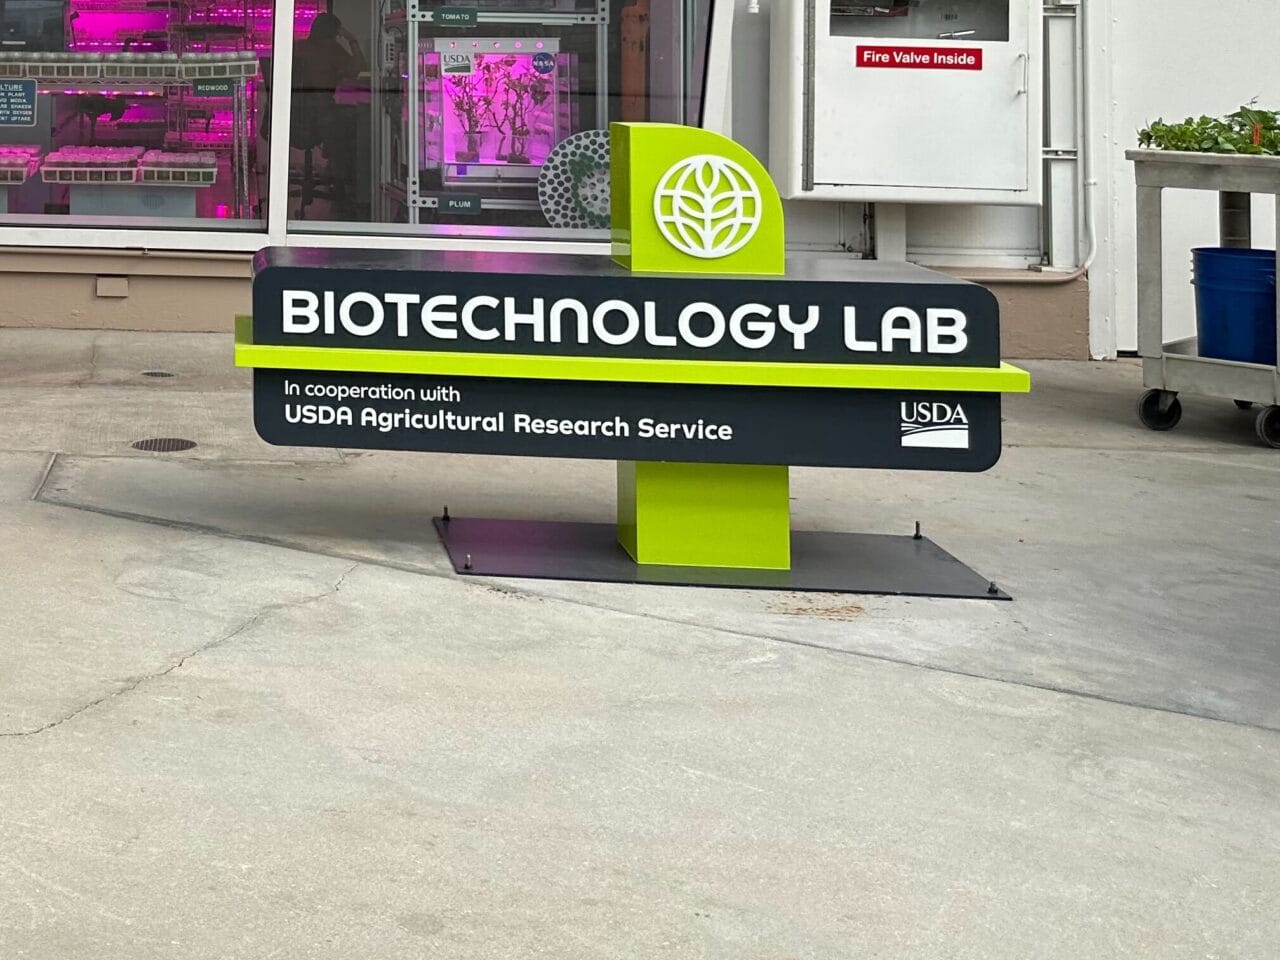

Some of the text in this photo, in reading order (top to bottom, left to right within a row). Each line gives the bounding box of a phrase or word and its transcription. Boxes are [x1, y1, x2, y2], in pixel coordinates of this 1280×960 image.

[443, 54, 471, 64] USDA
[863, 50, 976, 66] Fire Valve Inside
[449, 200, 471, 208] PLUM
[282, 290, 968, 354] BIOTECHNOLOGY LAB
[284, 380, 461, 402] In cooperation with
[284, 404, 733, 441] USDA Agricultural Research Service
[900, 401, 969, 424] USDA
